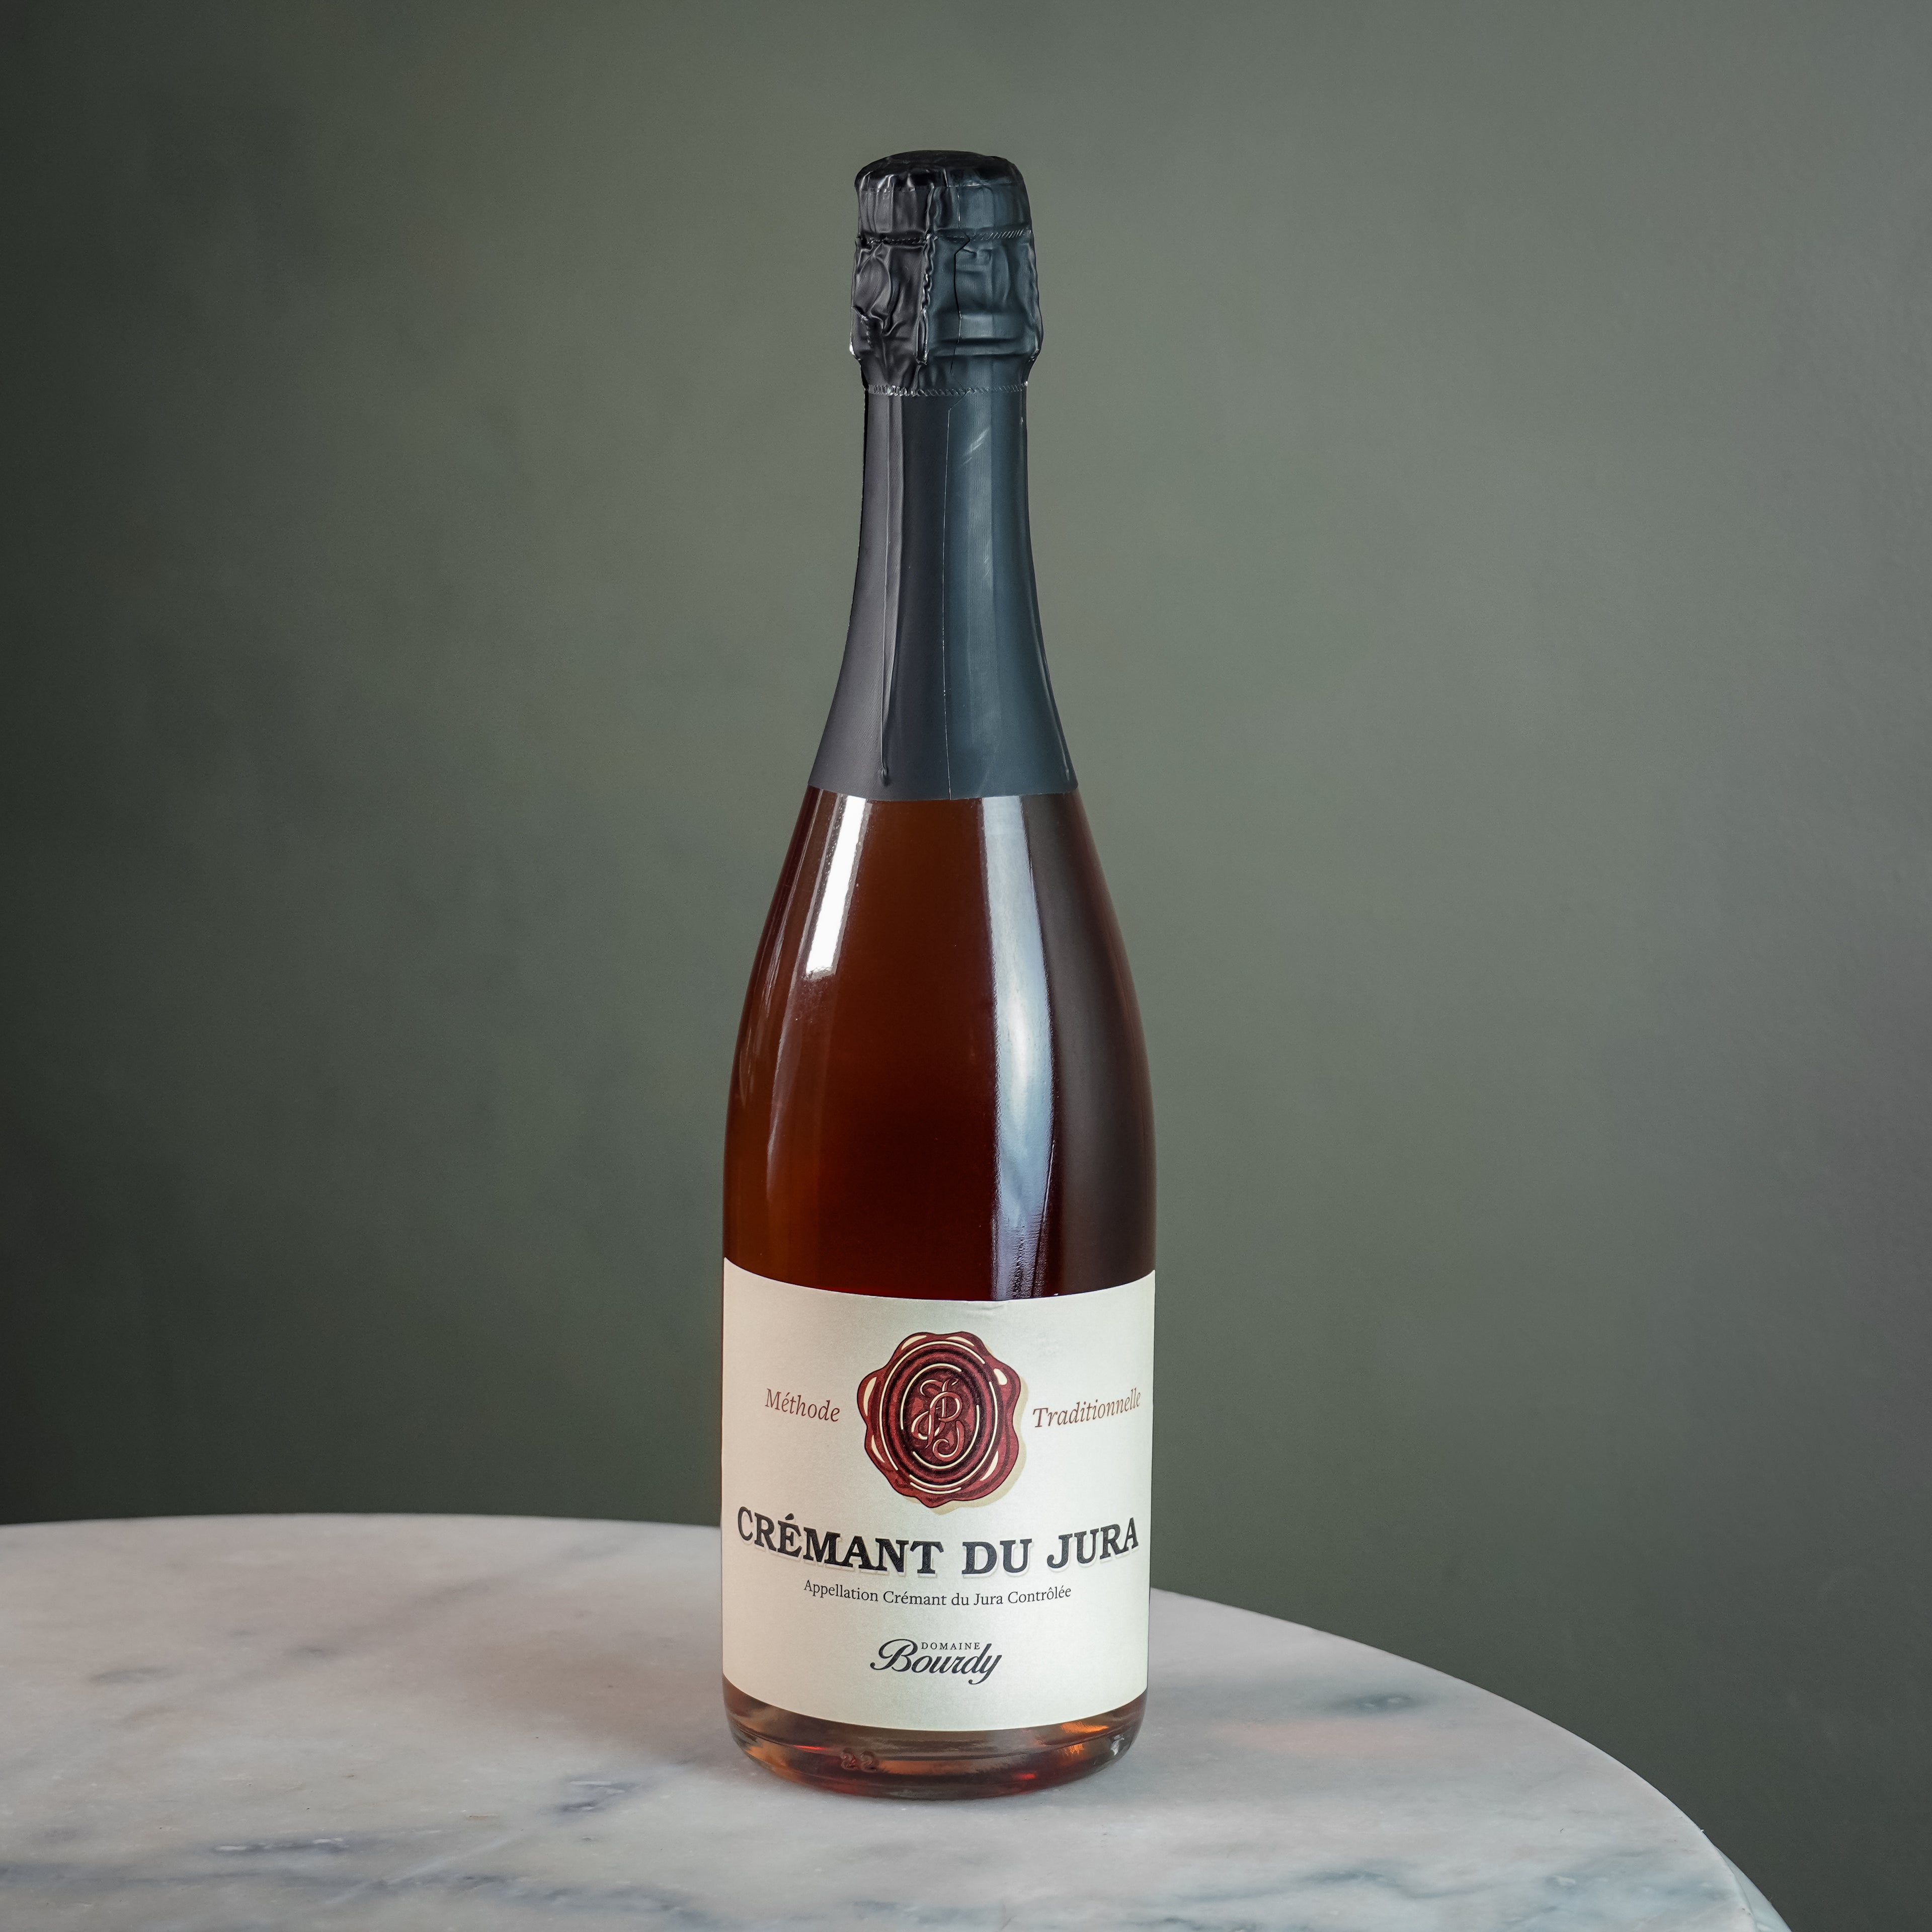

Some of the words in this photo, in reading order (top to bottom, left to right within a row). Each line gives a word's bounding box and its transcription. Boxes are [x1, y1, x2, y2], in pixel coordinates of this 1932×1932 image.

[765, 1388, 840, 1422] Méthode
[1032, 1387, 1141, 1428] Traditionnelle
[738, 1506, 944, 1574] CRÉMANT
[961, 1538, 1032, 1575] DU
[1046, 1517, 1139, 1569] JURA
[803, 1579, 879, 1602] Appellation
[883, 1590, 947, 1605] Crémant
[951, 1592, 970, 1606] du
[973, 1593, 1004, 1605] Jura
[1007, 1585, 1071, 1604] Contrôlée
[869, 1638, 1002, 1685] Bourdy
[921, 1642, 980, 1650] DOMAINE
